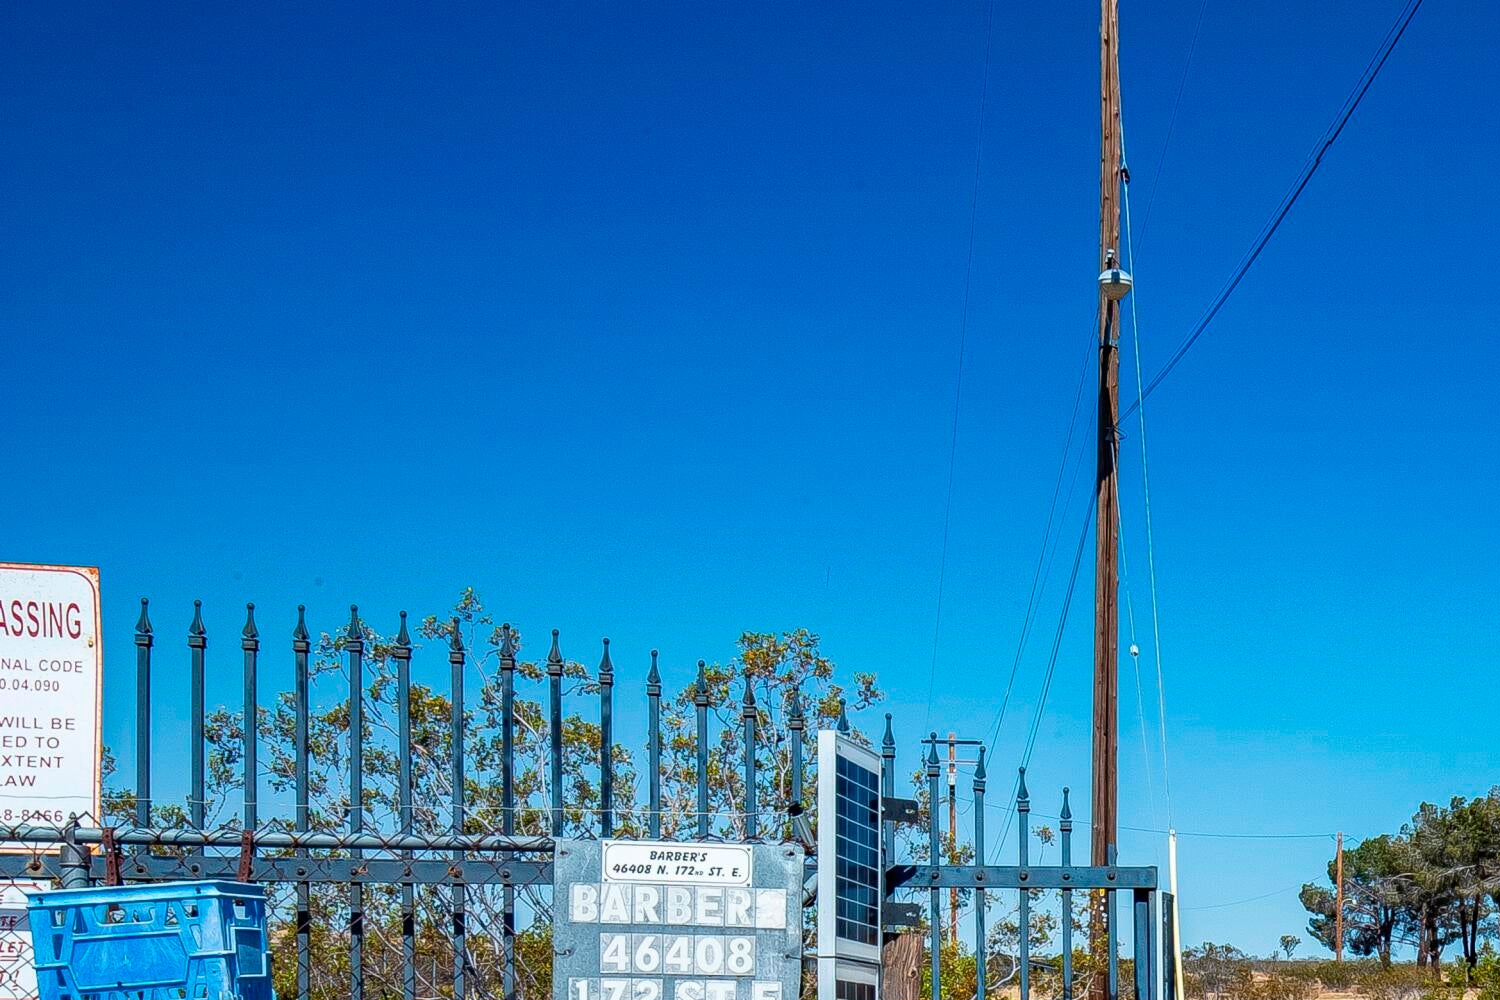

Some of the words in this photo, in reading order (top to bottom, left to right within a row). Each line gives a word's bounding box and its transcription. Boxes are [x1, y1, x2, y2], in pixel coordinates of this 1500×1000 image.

[38, 659, 84, 674] CODE
[0, 716, 43, 730] WILL
[51, 717, 76, 731] BE
[2, 735, 28, 748] ED
[34, 736, 60, 749] TO
[1, 754, 64, 768] XTENT
[649, 850, 708, 862] BARBER'S
[612, 863, 652, 875] 46408
[656, 865, 669, 875] N.
[708, 866, 726, 877] ST.
[731, 867, 742, 878] E.
[572, 883, 751, 927] BARBER
[602, 934, 753, 974] 46408
